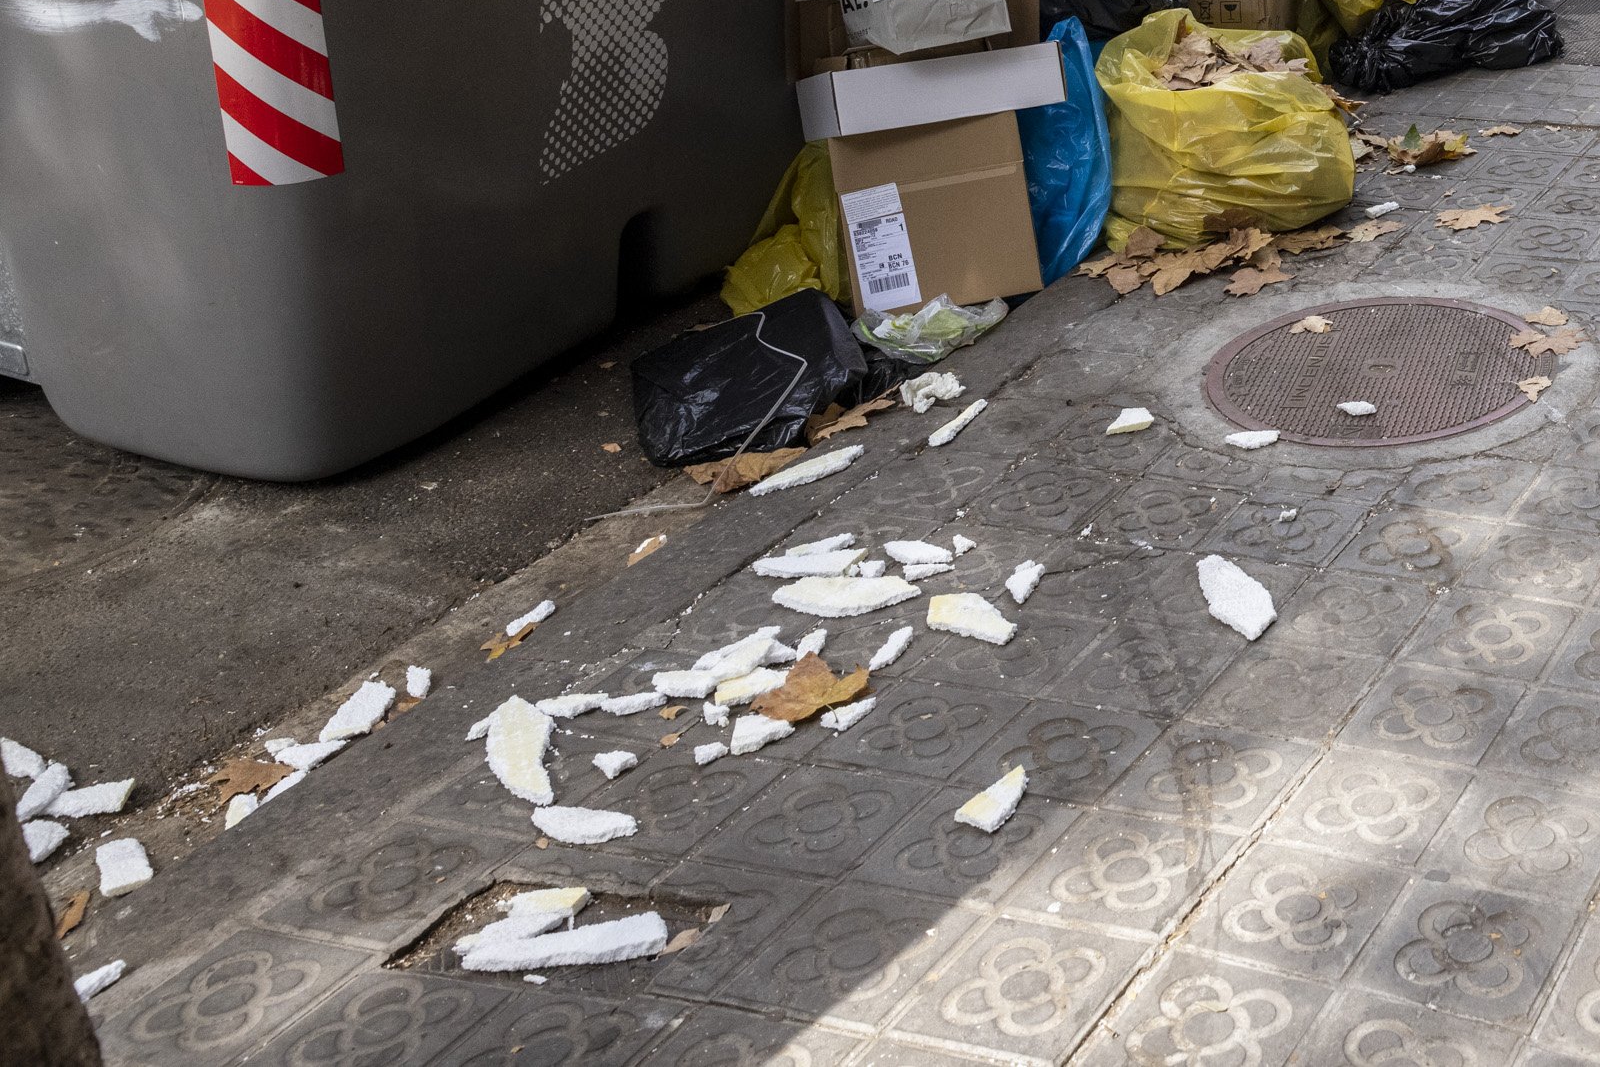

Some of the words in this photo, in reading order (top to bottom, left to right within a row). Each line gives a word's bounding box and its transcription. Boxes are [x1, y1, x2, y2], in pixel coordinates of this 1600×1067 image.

[899, 223, 904, 231] 1
[888, 253, 902, 261] BCN
[888, 261, 900, 269] BCN
[1290, 336, 1335, 402] INCENDIS
